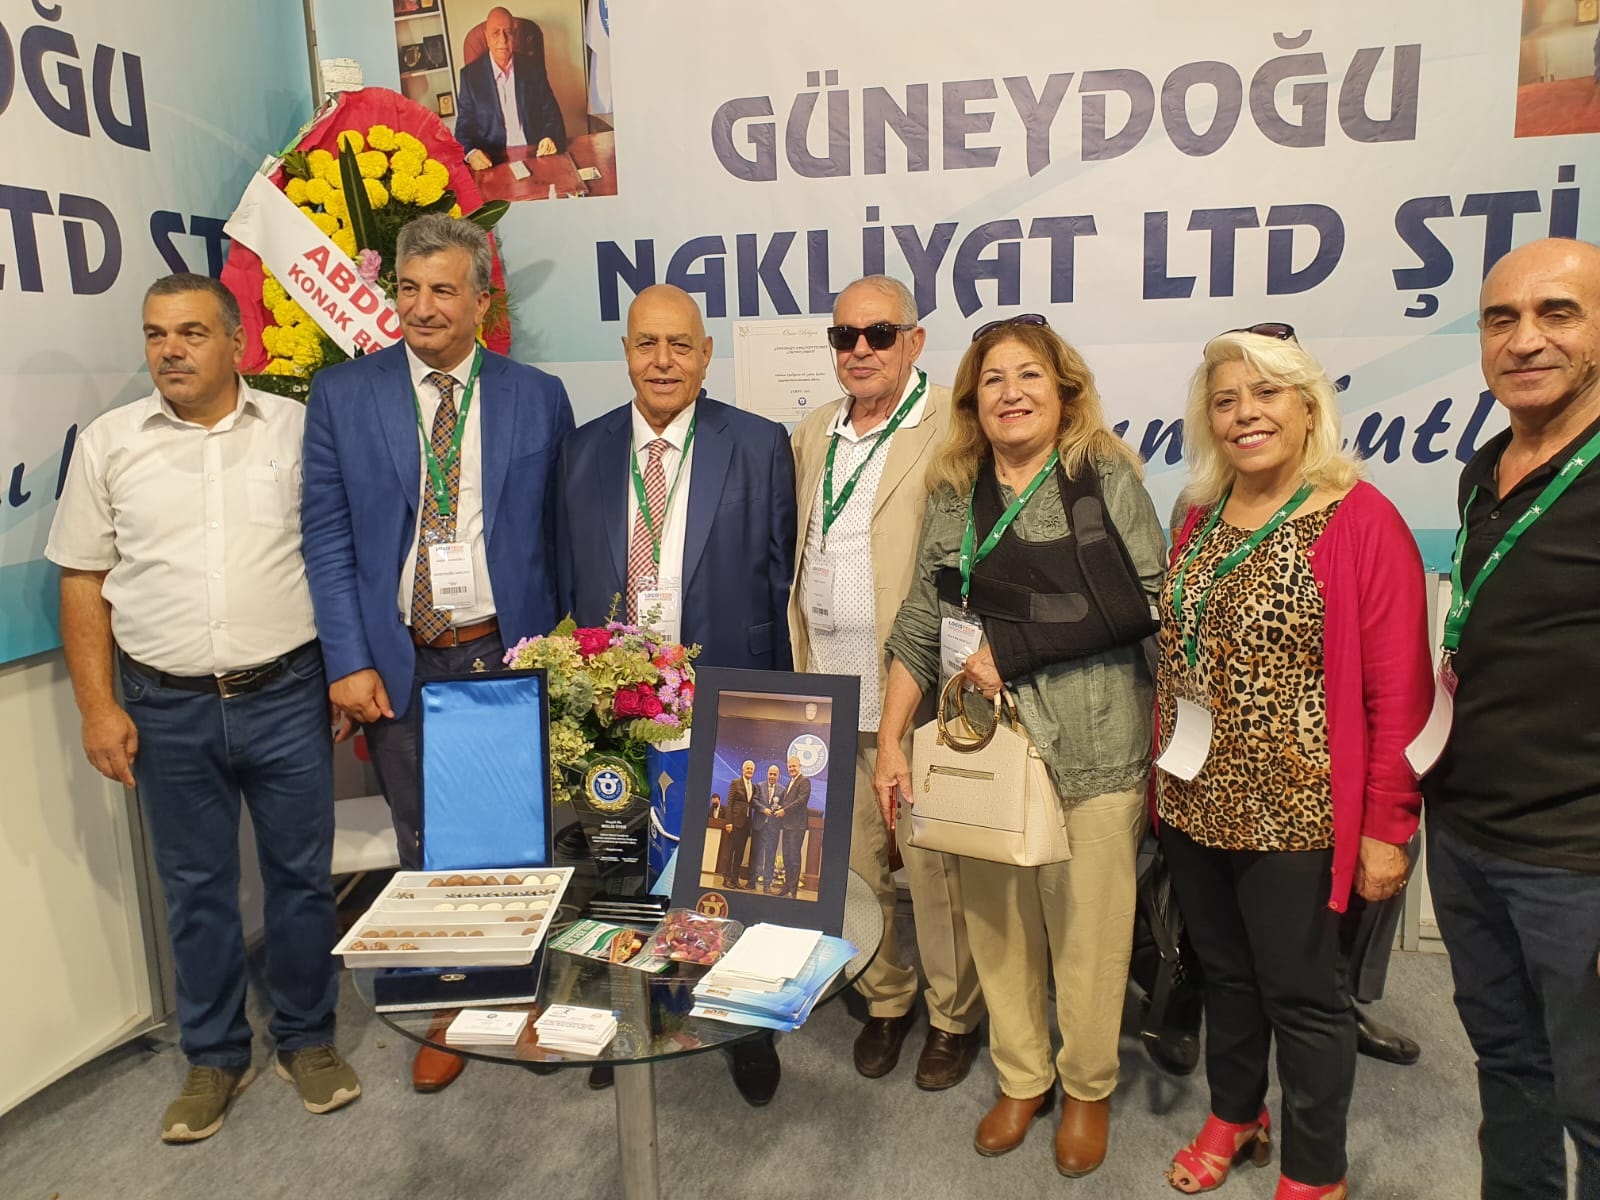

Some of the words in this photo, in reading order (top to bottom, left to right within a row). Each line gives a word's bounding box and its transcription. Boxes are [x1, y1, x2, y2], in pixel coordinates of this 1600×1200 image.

[0, 0, 151, 152] ĞU
[711, 29, 1422, 182] GÜNEYDOĞU
[0, 184, 122, 295] TD
[288, 263, 354, 332] KONAK
[596, 205, 1097, 321] NAKLİYAT
[1142, 203, 1345, 300] LTD
[1392, 164, 1580, 318] ŞTİ
